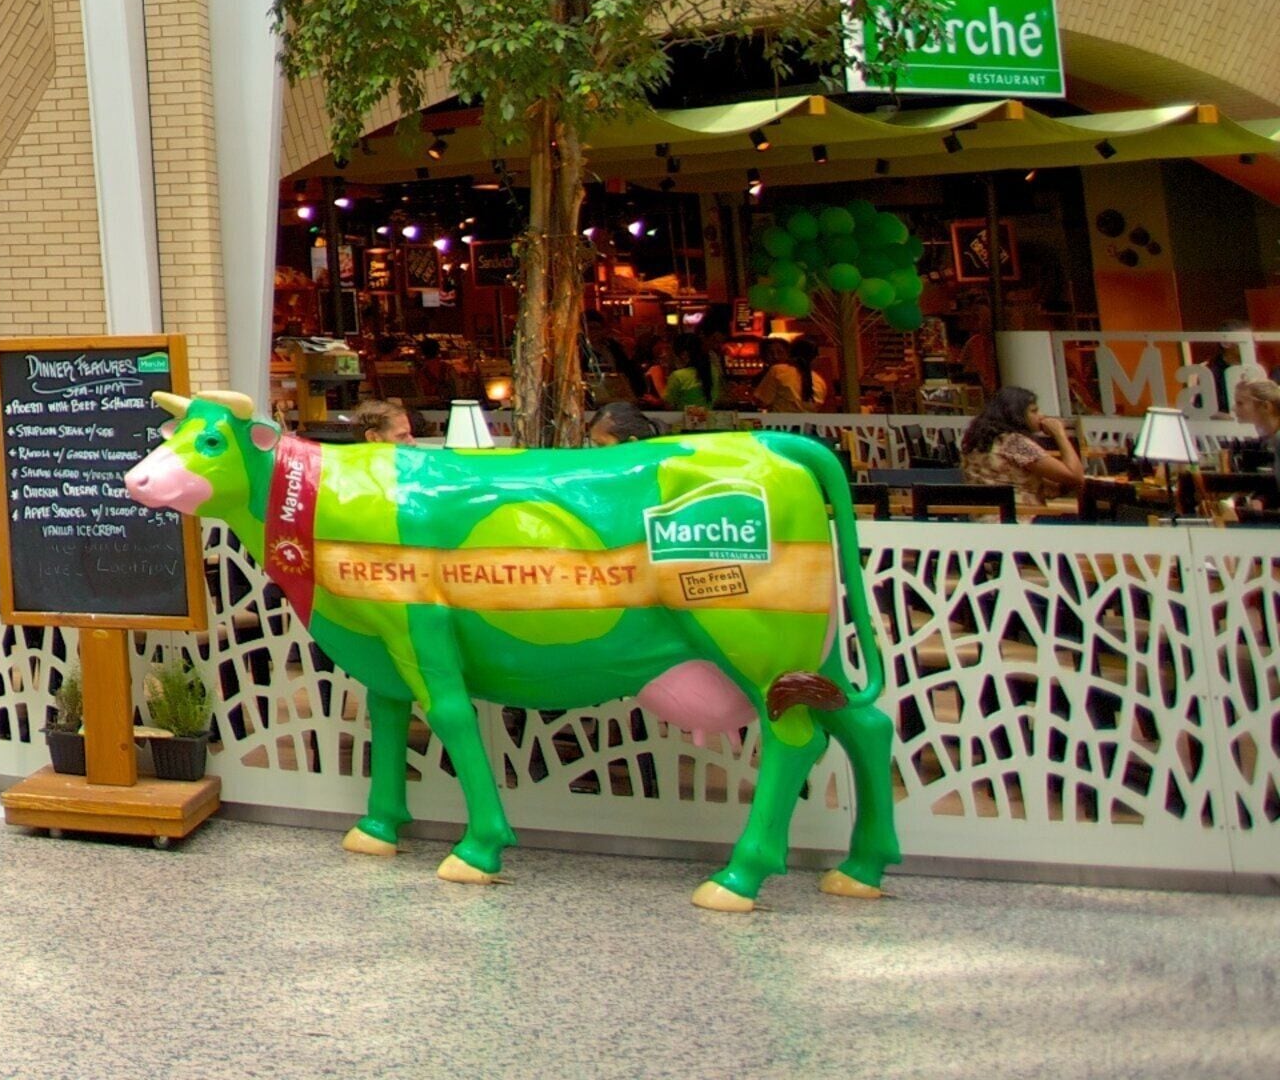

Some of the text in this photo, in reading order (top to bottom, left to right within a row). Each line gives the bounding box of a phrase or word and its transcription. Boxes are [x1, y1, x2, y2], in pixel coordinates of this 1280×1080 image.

[968, 73, 1046, 87] RESTAURANT
[25, 354, 137, 381] DINNER FEATURES
[62, 482, 98, 497] CAESAR
[280, 458, 304, 522] Marché
[24, 506, 51, 519] APPLE
[654, 517, 756, 544] Marché
[339, 561, 416, 583] FRESH
[442, 564, 556, 585] HEALTHY
[574, 565, 637, 587] FAST
[686, 569, 741, 586] The Fresh
[688, 582, 742, 596] Concept
